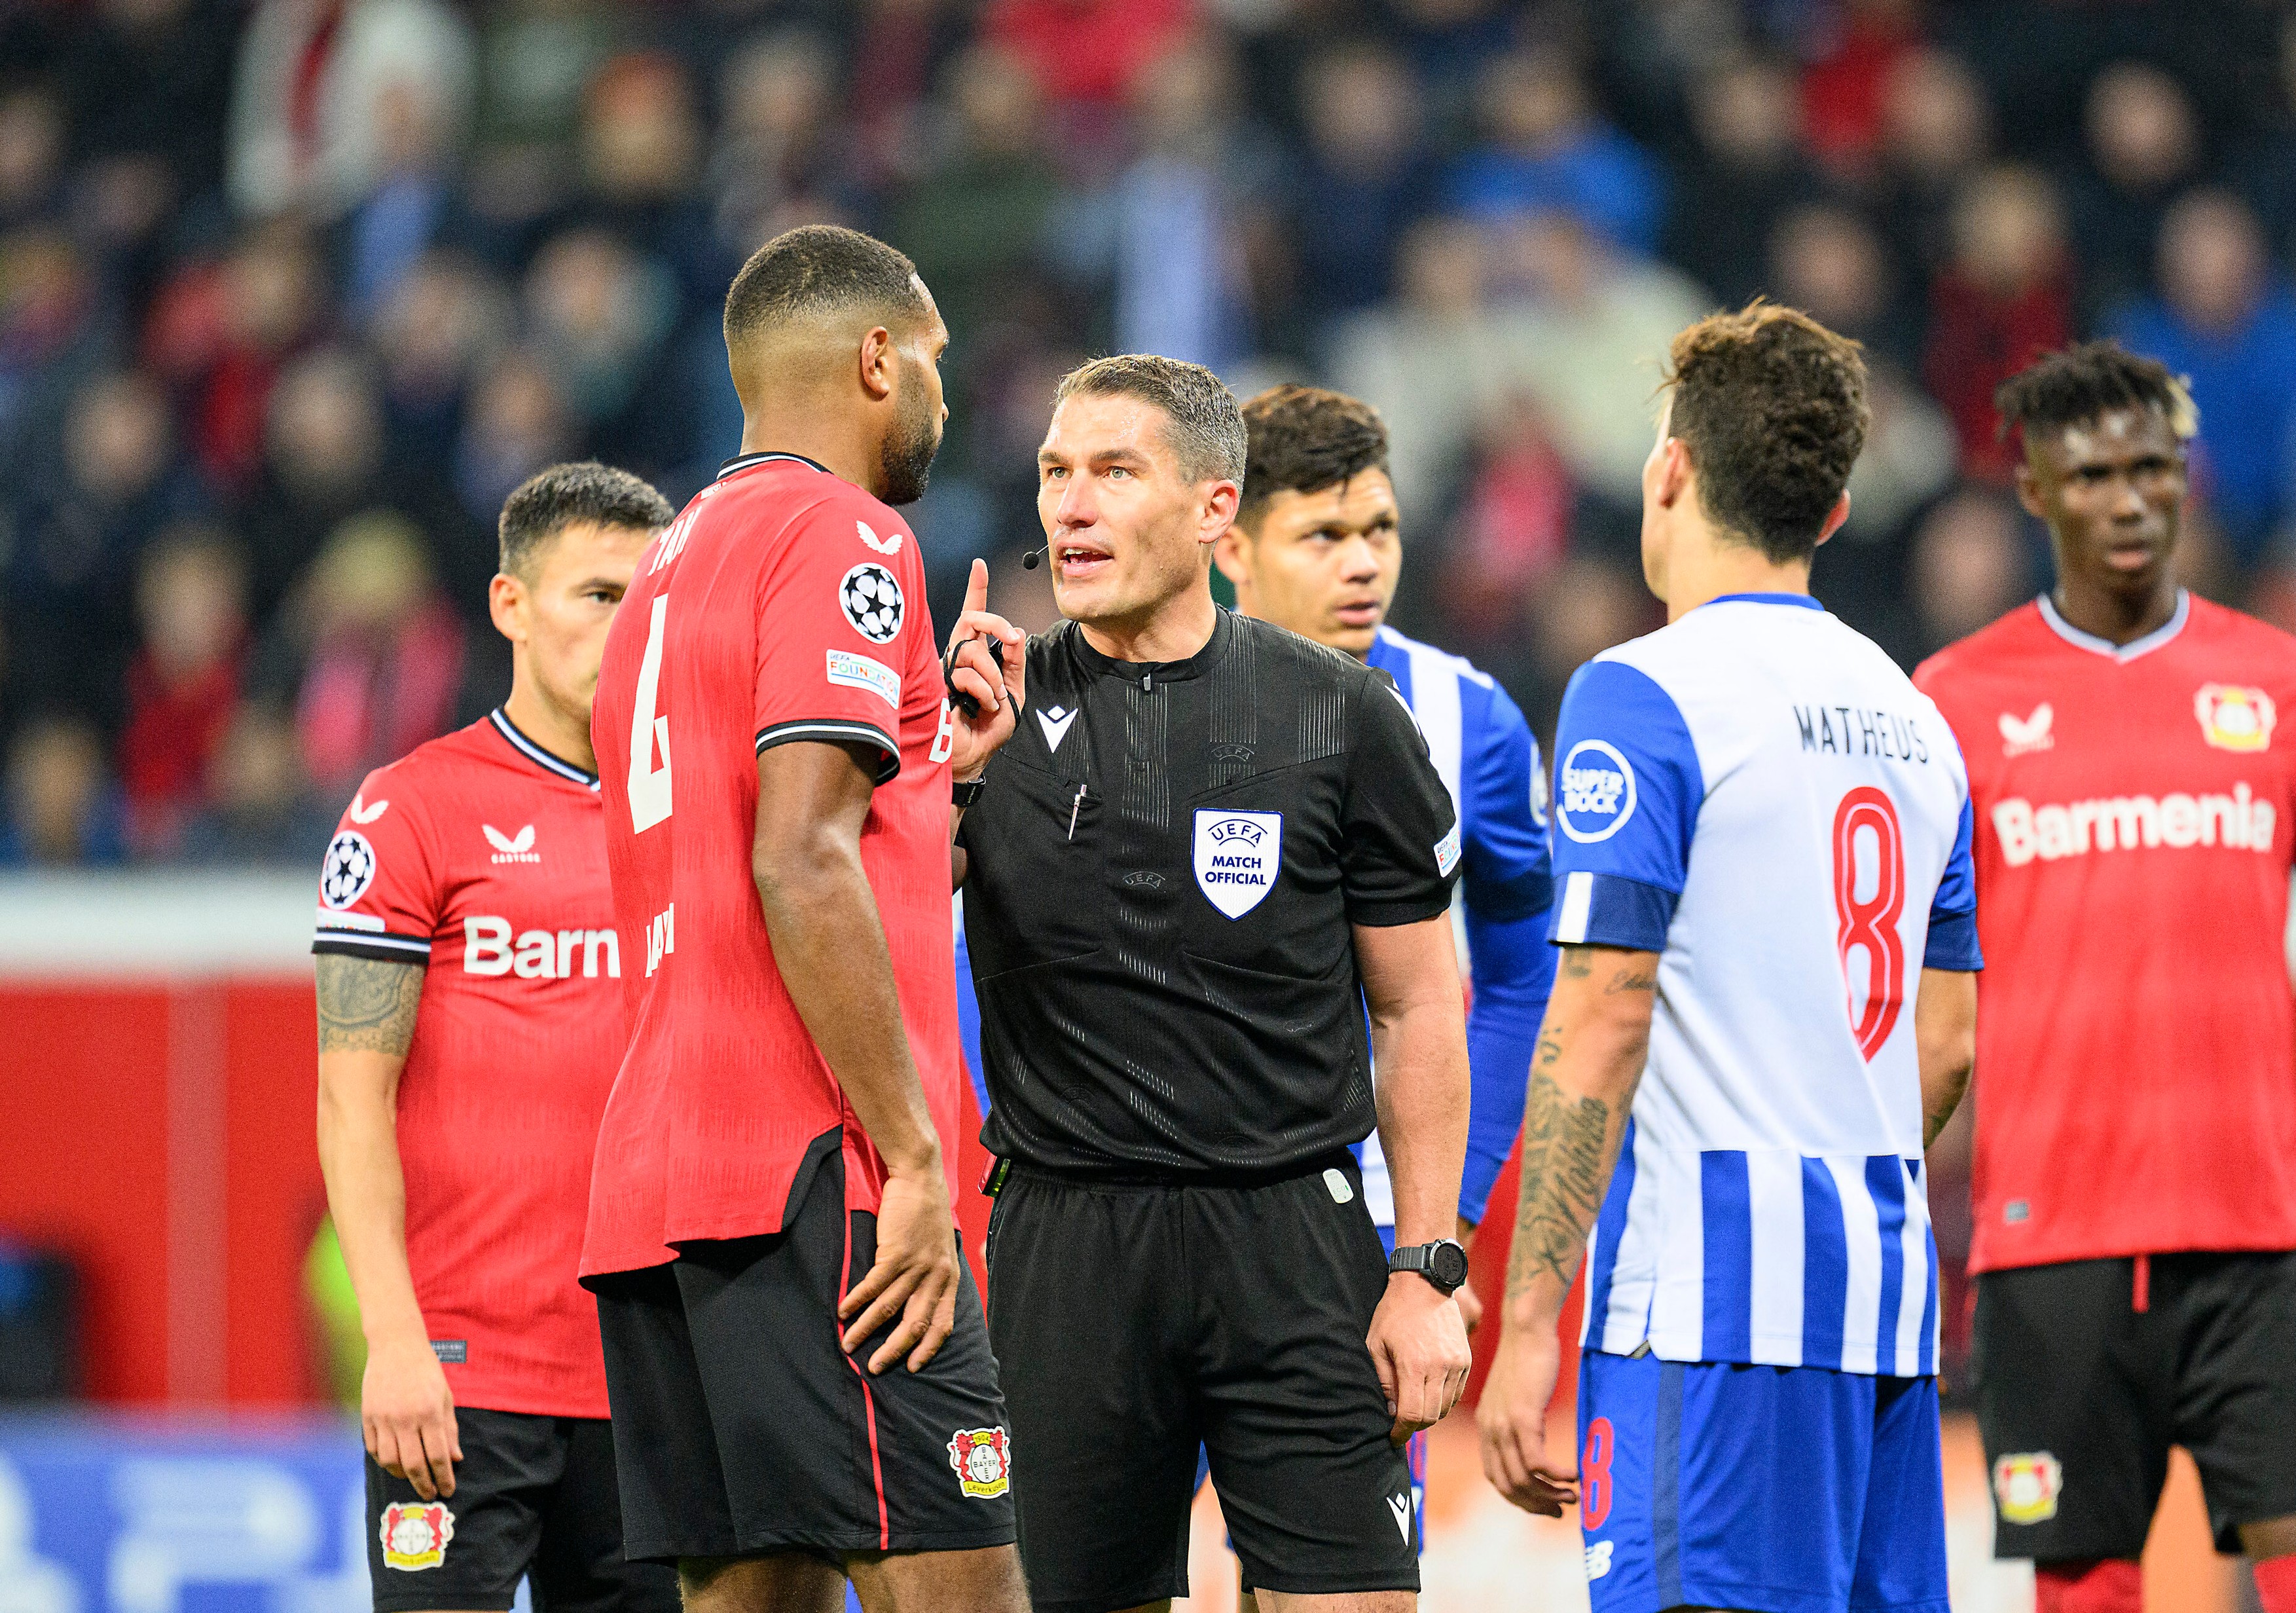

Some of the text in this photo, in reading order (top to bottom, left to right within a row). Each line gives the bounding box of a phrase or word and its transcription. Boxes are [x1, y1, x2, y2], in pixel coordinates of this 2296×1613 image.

[627, 592, 674, 835] 4
[1793, 705, 1928, 764] MATHEUS
[1561, 768, 1624, 795] SUPER
[1211, 823, 1262, 845] UEFA
[1991, 781, 2277, 868] Barmenia
[1212, 855, 1262, 869] MATCH
[1125, 874, 1162, 888] UEFA
[1205, 871, 1267, 885] OFFICIAL
[1832, 786, 1905, 1066] 8
[973, 1460, 996, 1468] BAYER
[1582, 1417, 1614, 1531] 8
[967, 1481, 1005, 1493] Leverkusen
